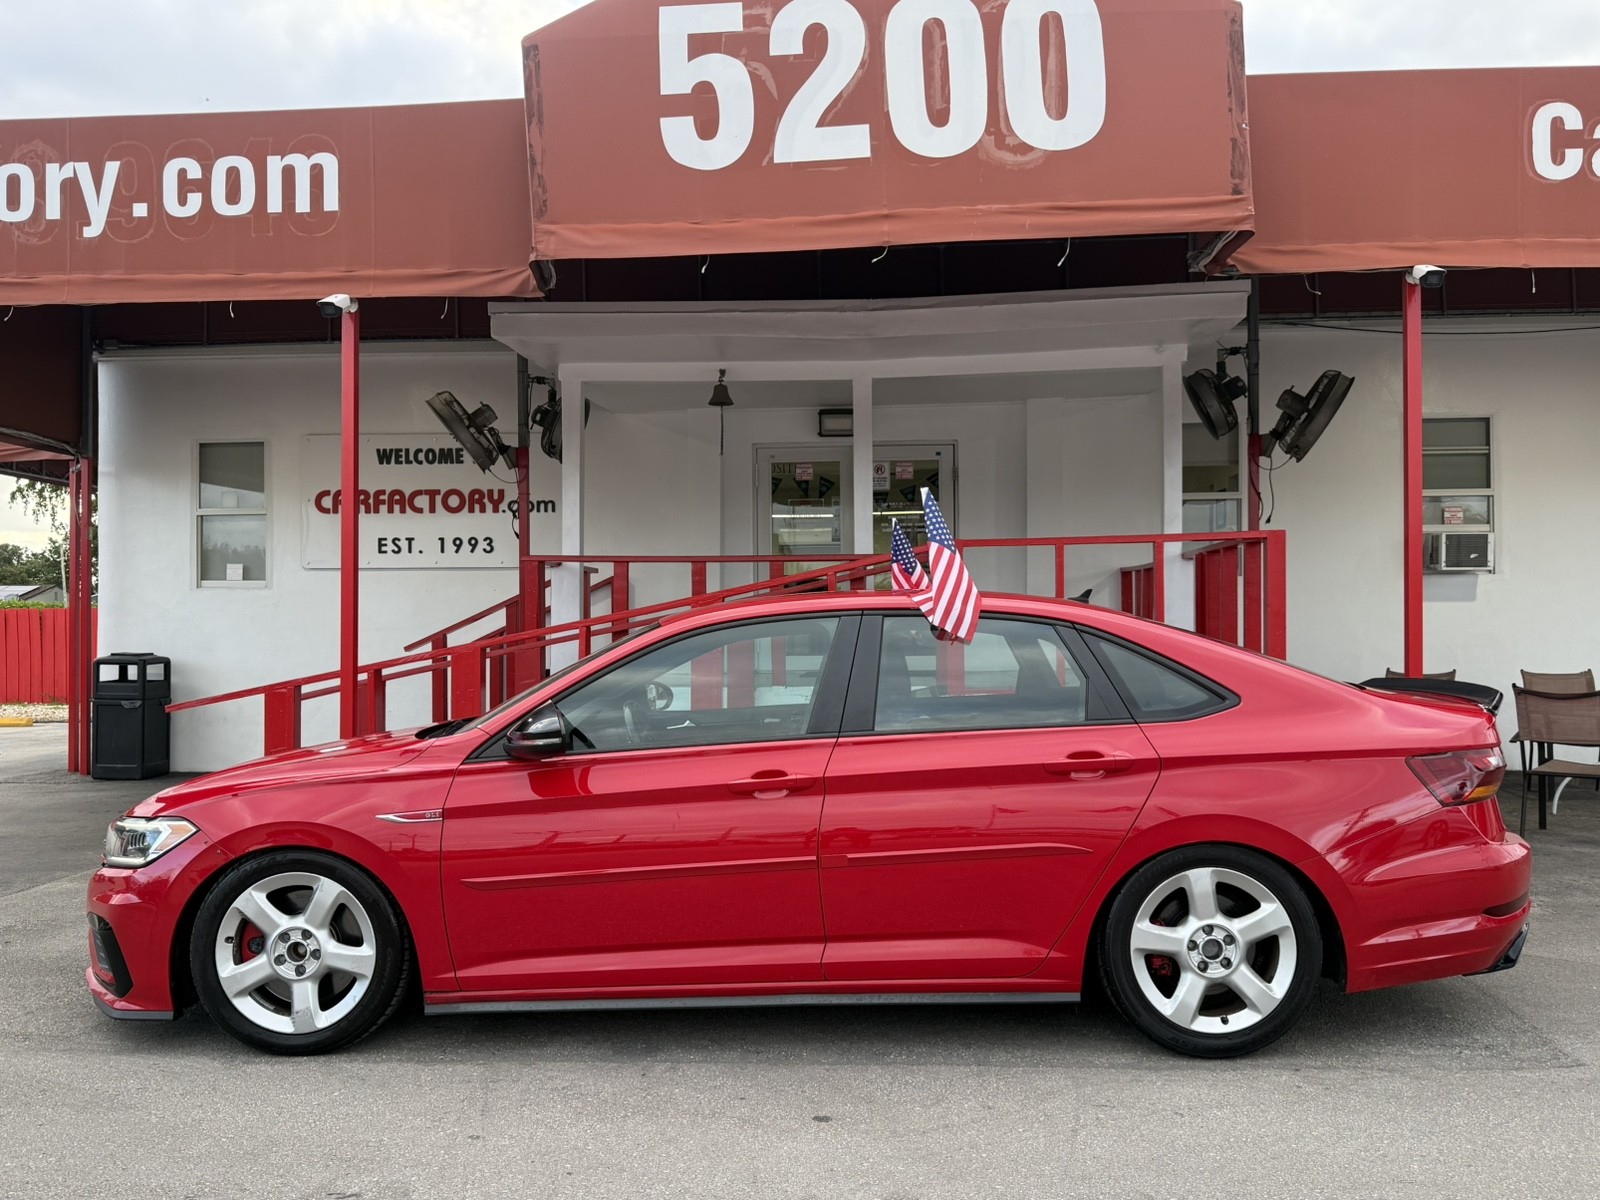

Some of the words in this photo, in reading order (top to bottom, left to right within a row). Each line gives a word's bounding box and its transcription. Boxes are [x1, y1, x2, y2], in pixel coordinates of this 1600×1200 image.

[658, 0, 1107, 171] 5200
[1531, 101, 1600, 181] C
[0, 152, 340, 238] ory.com
[376, 447, 464, 465] WELCOME
[377, 537, 423, 554] EST.
[438, 536, 495, 554] 1993
